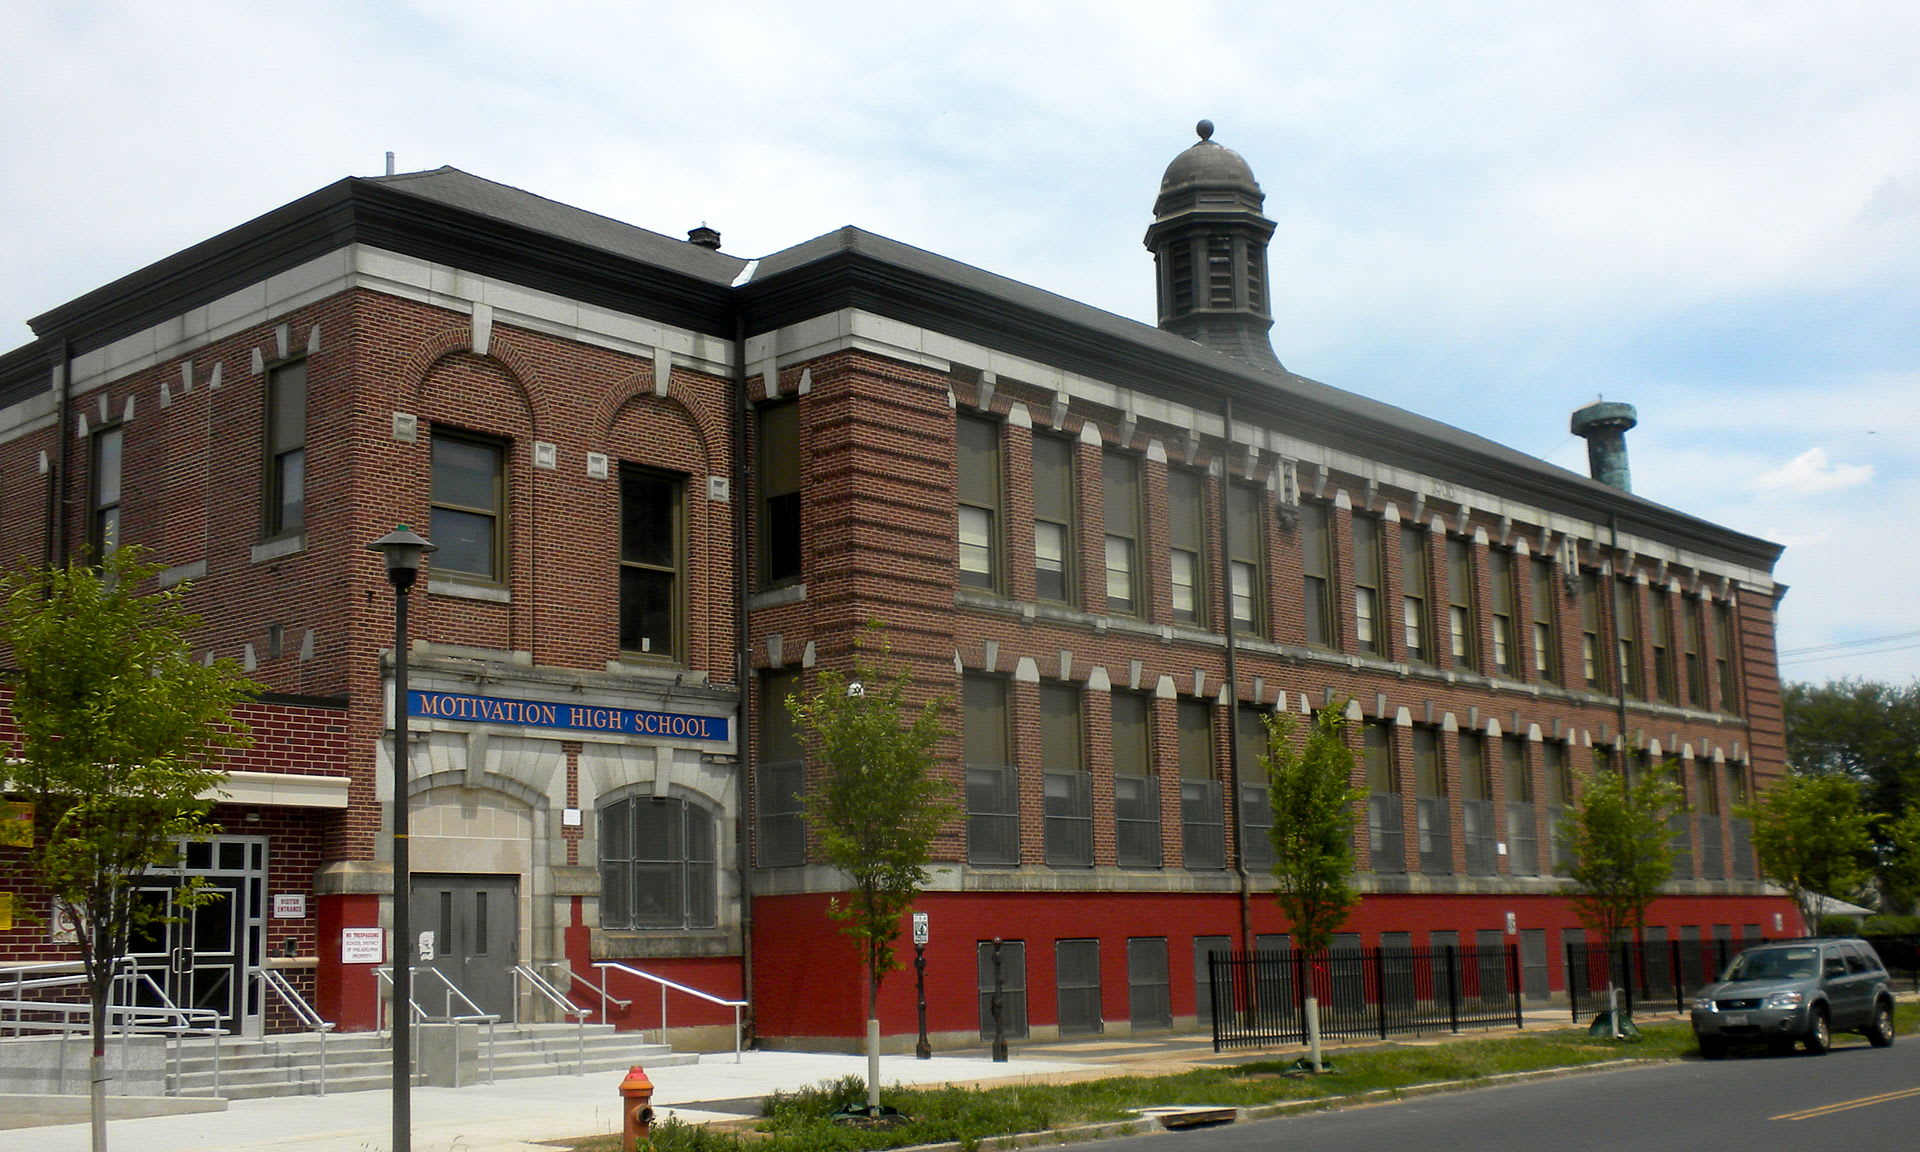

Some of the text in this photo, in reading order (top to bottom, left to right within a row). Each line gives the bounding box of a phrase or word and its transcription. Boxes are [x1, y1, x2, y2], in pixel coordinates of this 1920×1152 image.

[420, 694, 711, 737] MOTIVATION HIGH SCHOOL
